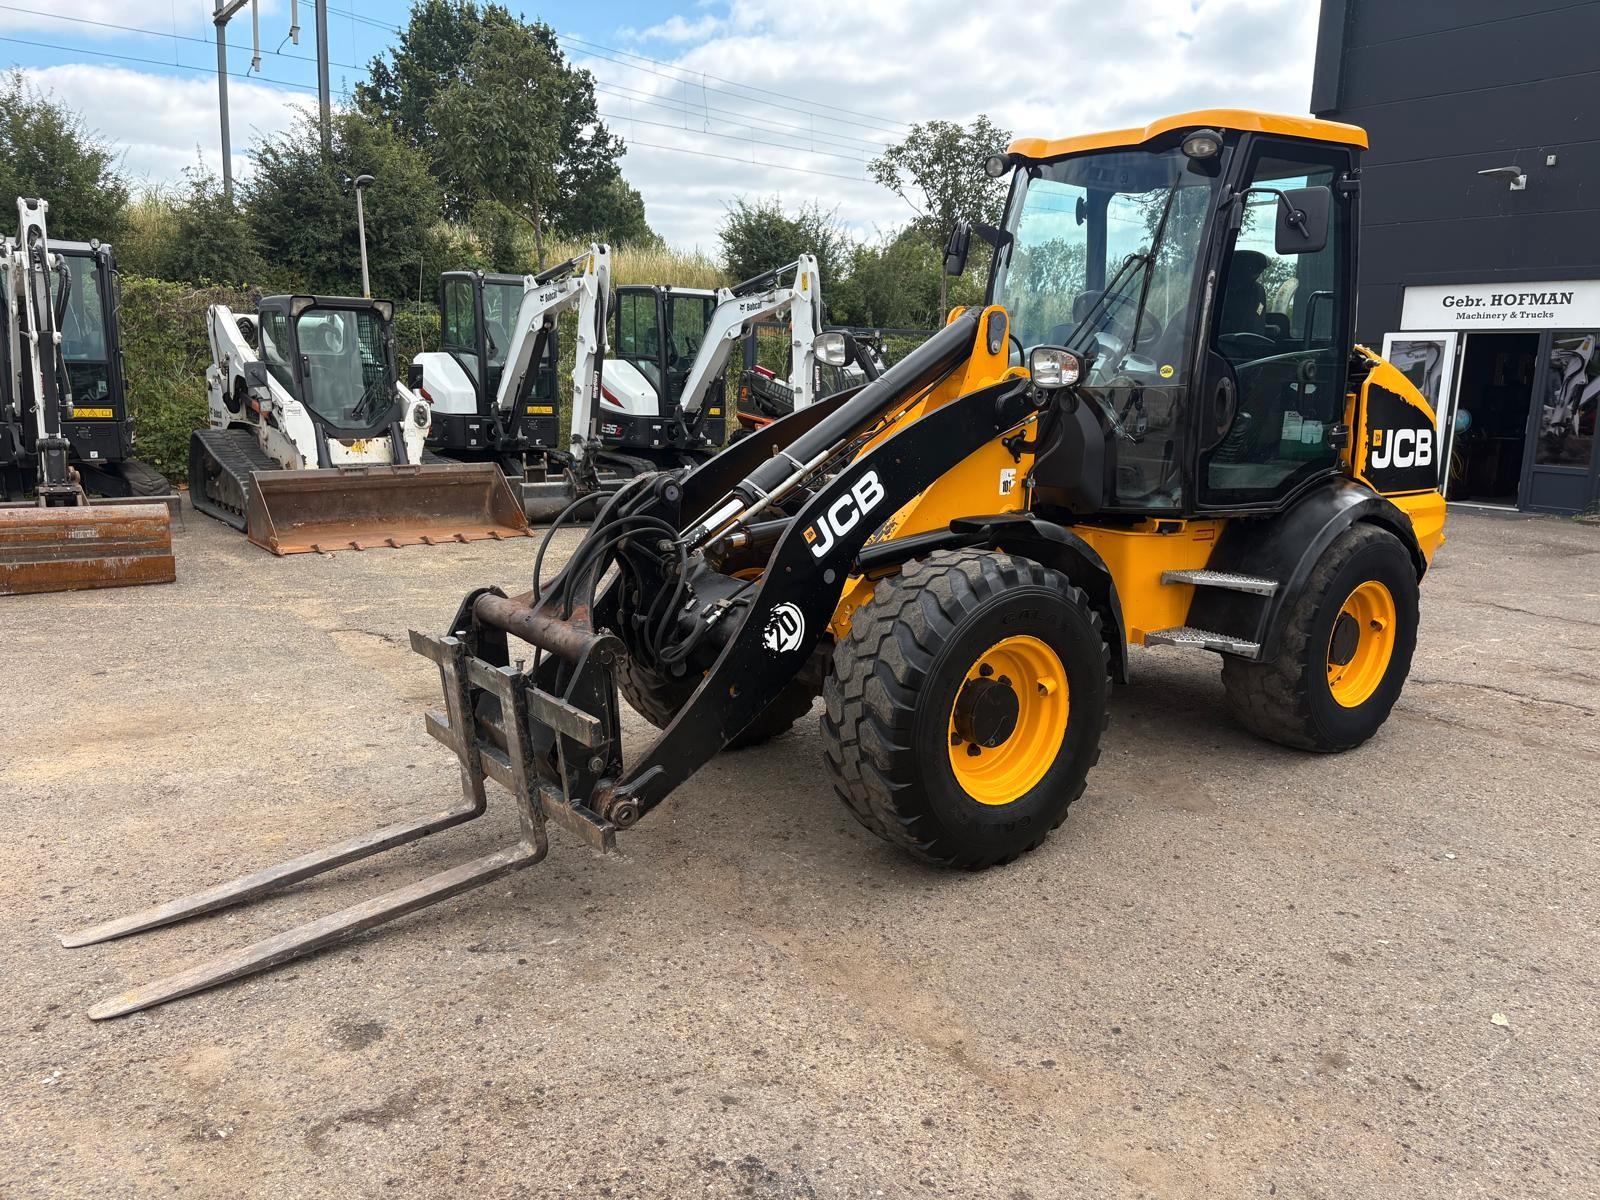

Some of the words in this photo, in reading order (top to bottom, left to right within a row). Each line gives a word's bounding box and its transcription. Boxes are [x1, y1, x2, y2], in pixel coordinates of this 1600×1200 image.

[544, 289, 558, 303] Bobcat
[1442, 295, 1486, 308] Gebr.
[1489, 292, 1574, 306] HOFMAN
[747, 301, 762, 312] Bobcat
[1456, 312, 1508, 321] Machinery
[1509, 311, 1517, 320] &
[1519, 311, 1554, 320] Trucks
[1371, 428, 1432, 469] JCB
[811, 470, 885, 558] JCB
